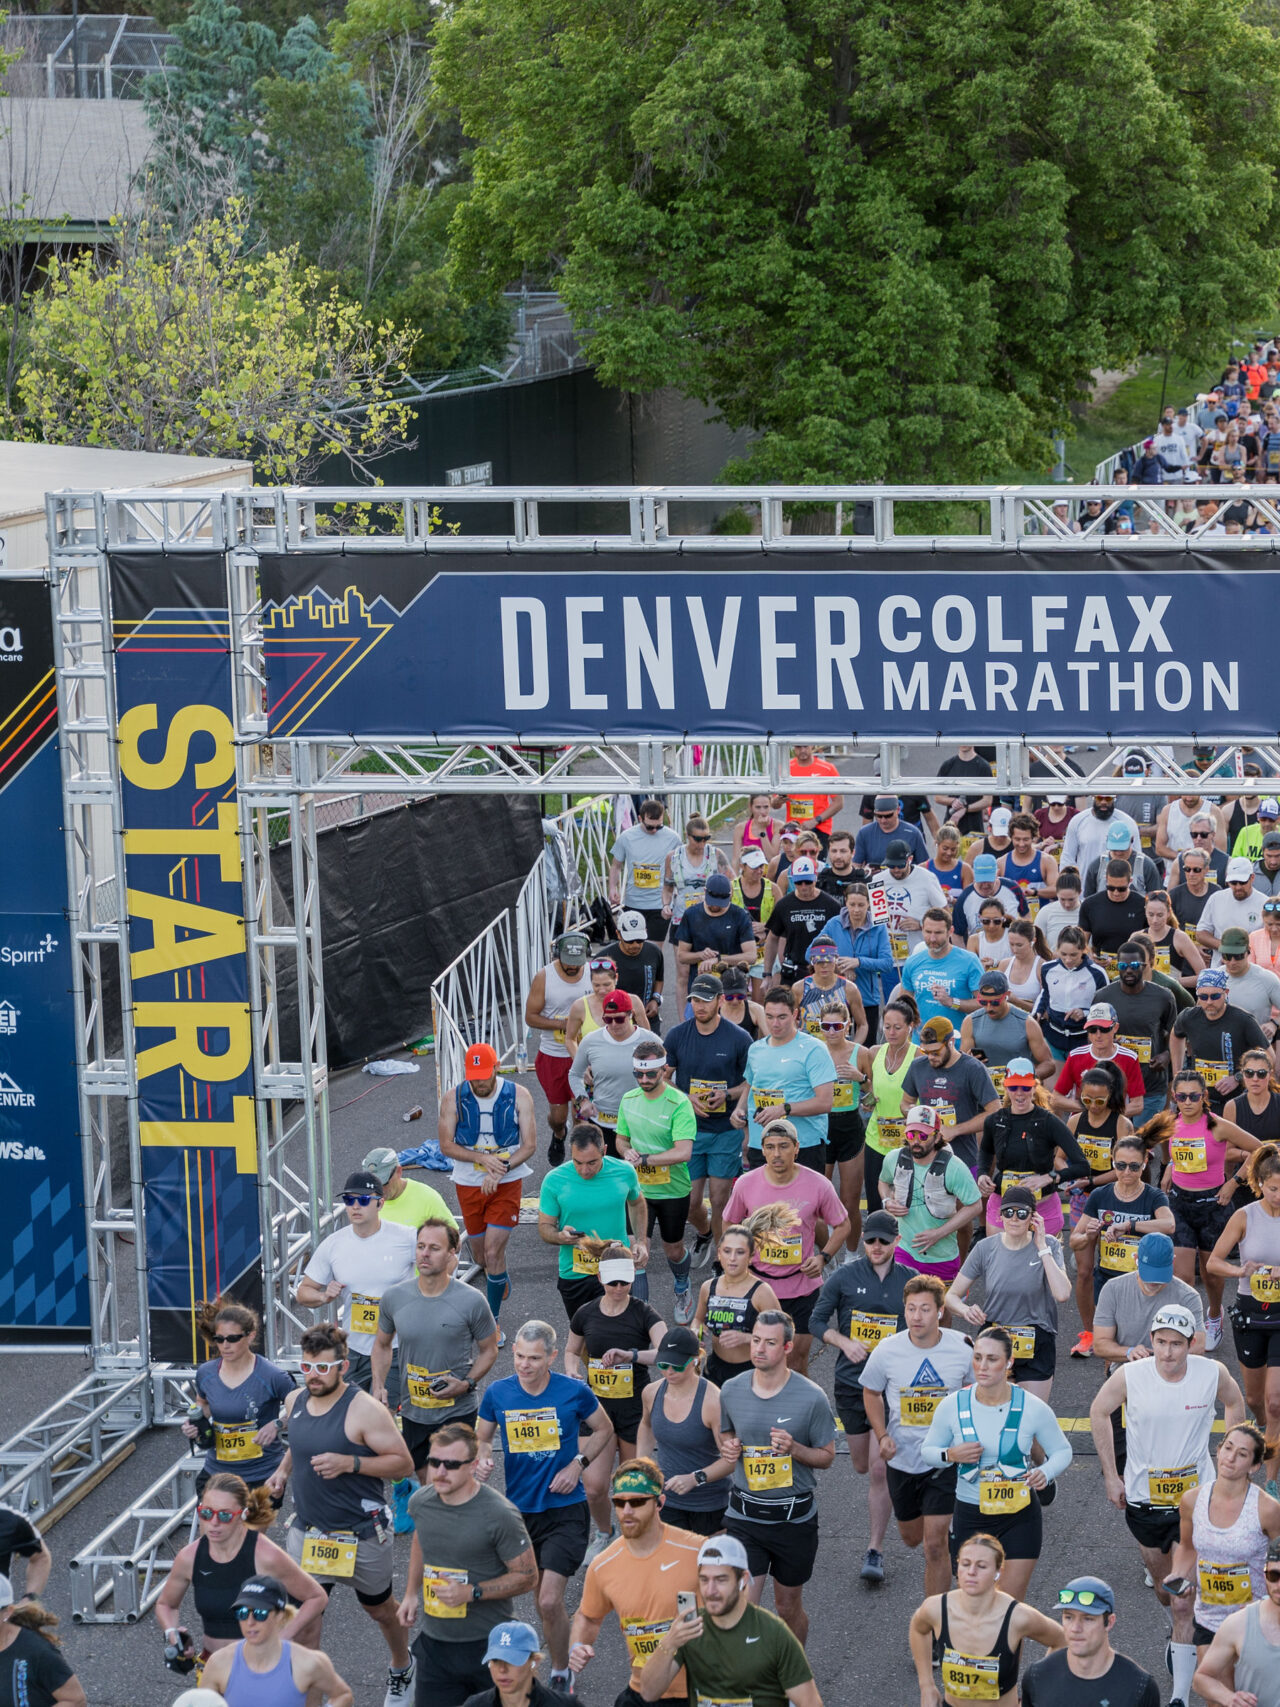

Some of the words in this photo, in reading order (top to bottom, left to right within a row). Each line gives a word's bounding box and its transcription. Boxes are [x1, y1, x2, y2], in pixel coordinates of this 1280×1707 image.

[878, 594, 1174, 653] COLFAX
[500, 596, 865, 711] DENVER
[882, 660, 1240, 712] MARATHON
[872, 889, 888, 918] 1:50
[117, 703, 257, 1175] START
[1175, 1151, 1193, 1161] 1570
[1104, 1246, 1126, 1257] 1646
[363, 1309, 376, 1322] 25
[856, 1326, 881, 1340] 1429
[593, 1374, 618, 1385] 1617
[414, 1385, 431, 1396] 154
[907, 1402, 934, 1413] 1652
[513, 1426, 540, 1438] 1481
[220, 1436, 245, 1449] 1375
[748, 1462, 776, 1475] 1473
[987, 1487, 1014, 1500] 1700
[1156, 1482, 1184, 1495] 1628
[311, 1545, 339, 1560] 1580
[1206, 1579, 1234, 1592] 1465
[949, 1669, 980, 1685] 8317
